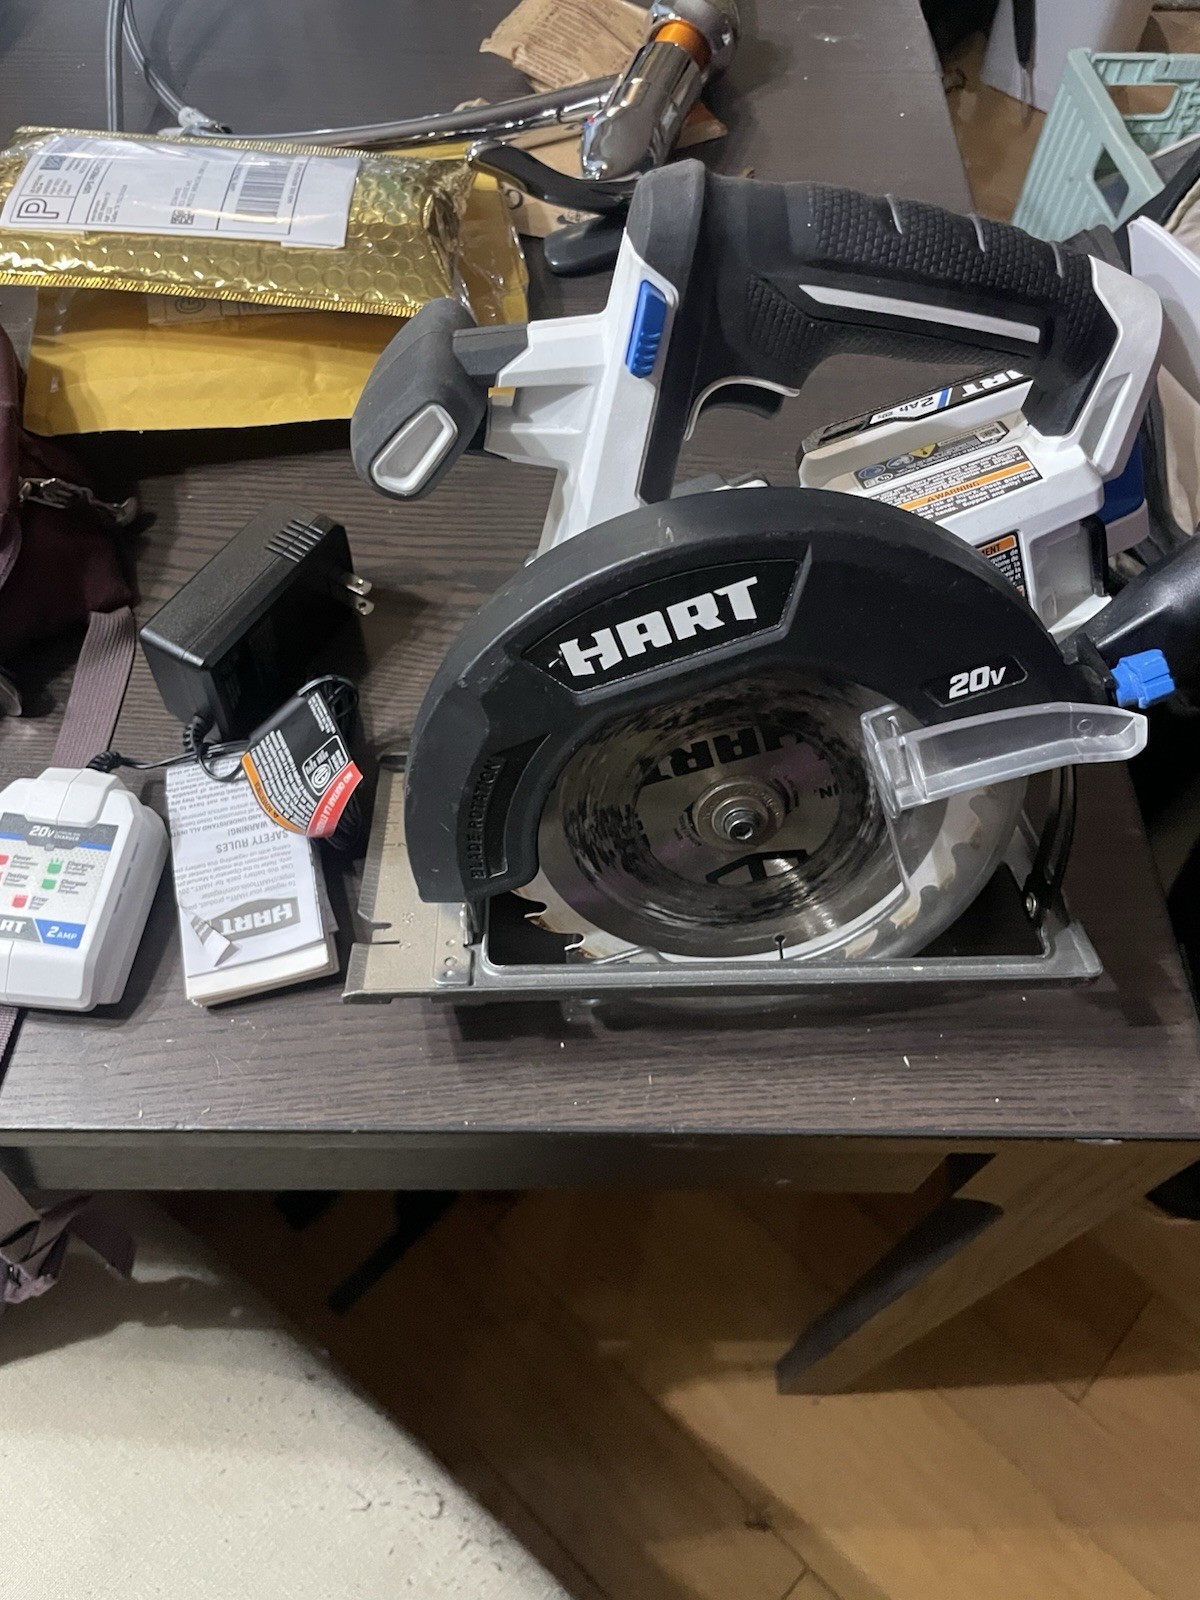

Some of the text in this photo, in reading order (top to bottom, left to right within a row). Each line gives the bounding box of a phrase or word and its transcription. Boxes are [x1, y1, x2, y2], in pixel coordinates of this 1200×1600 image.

[17, 197, 59, 220] P
[962, 369, 1023, 397] ART
[934, 480, 980, 500] WARNING
[558, 576, 759, 676] HART
[227, 820, 268, 836] WARNING!
[468, 759, 501, 879] BLADE ROTATION
[216, 829, 288, 854] SAFETY RULES
[220, 902, 293, 935] HART
